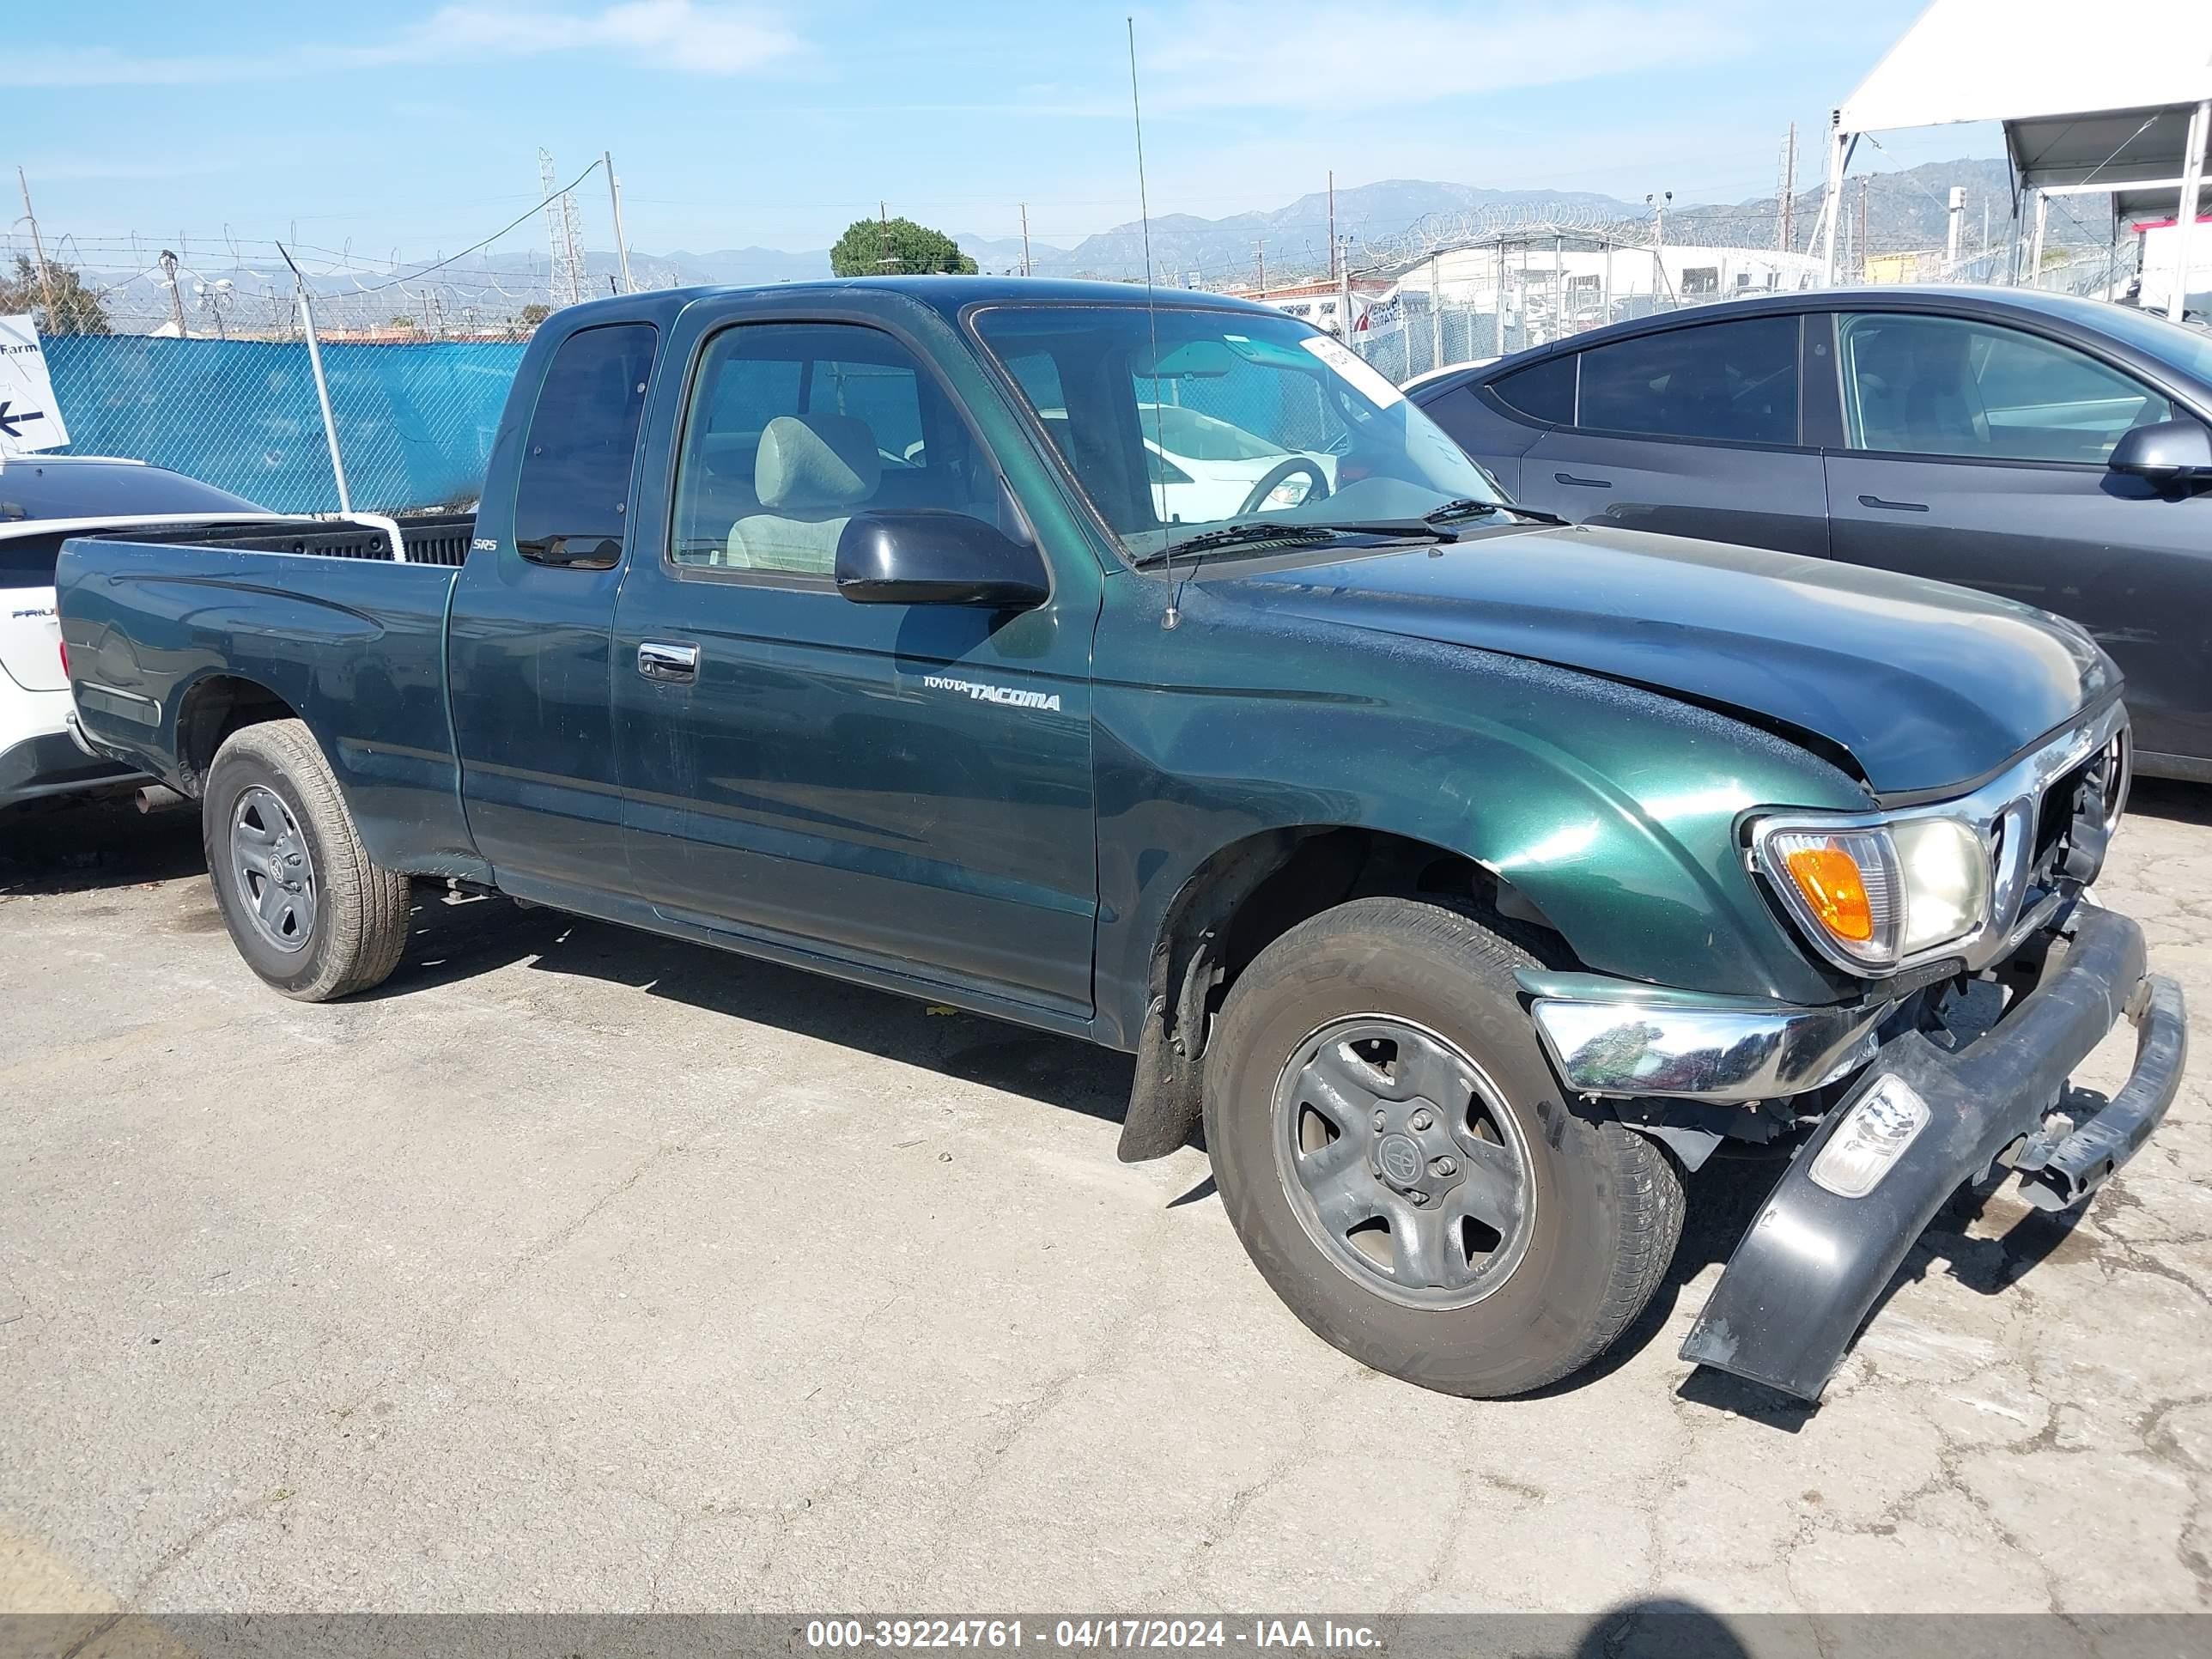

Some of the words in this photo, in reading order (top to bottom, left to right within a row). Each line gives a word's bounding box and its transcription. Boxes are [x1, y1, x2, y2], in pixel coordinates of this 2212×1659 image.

[1, 343, 38, 356] Farm
[923, 676, 968, 692] TOYOTA
[968, 684, 1060, 712] TACOMA
